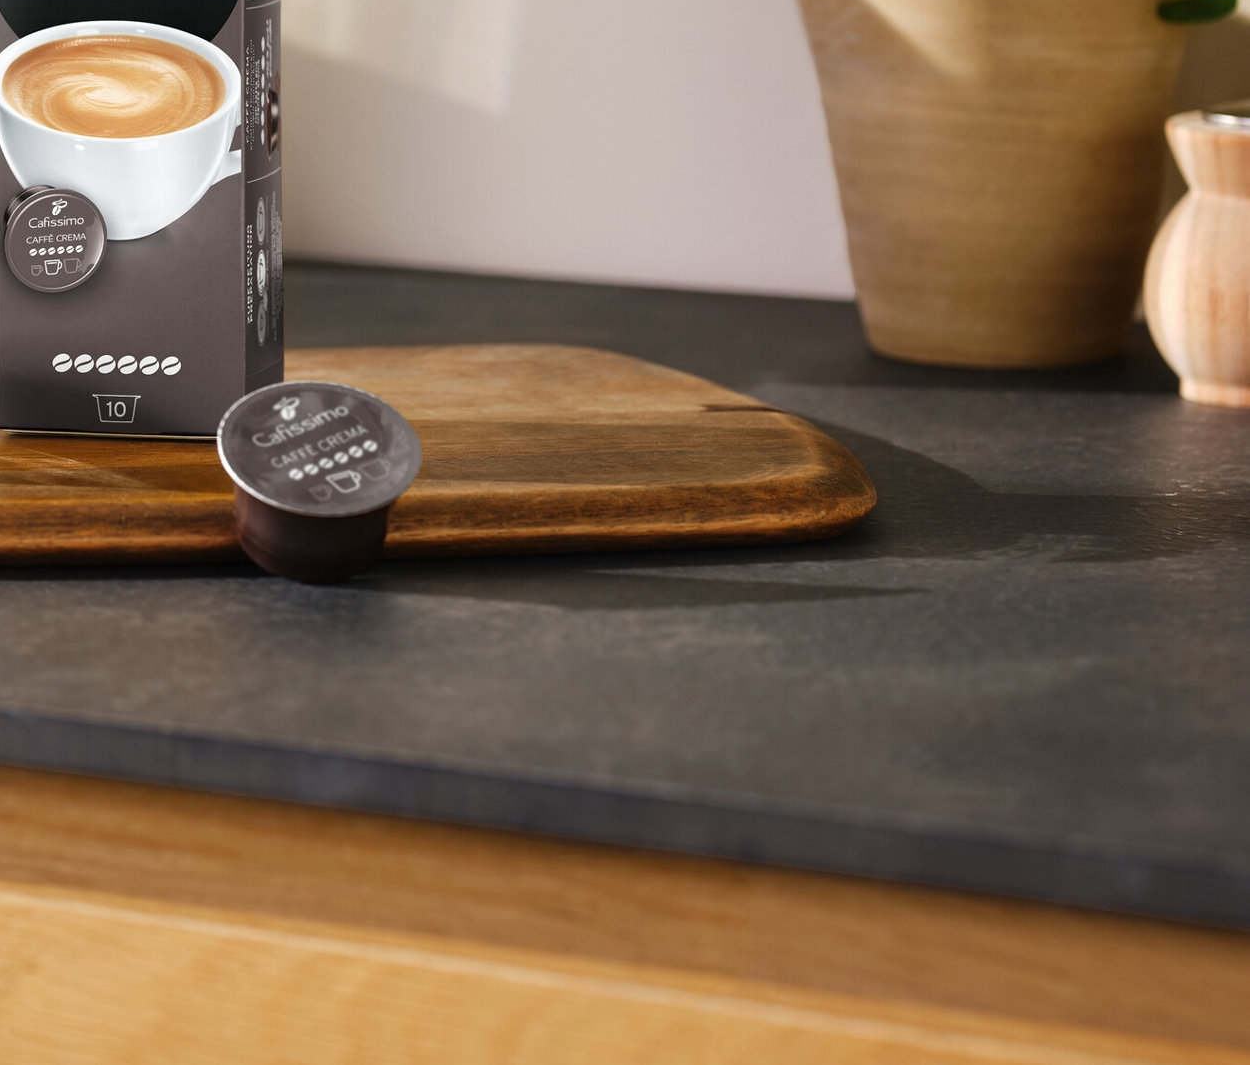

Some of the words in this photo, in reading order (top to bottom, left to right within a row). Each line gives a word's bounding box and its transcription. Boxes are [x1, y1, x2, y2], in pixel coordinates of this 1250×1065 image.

[28, 216, 85, 229] Cafissimo
[25, 234, 54, 245] CAFFÈ
[56, 233, 87, 243] CREMA
[105, 401, 127, 419] 10
[252, 405, 349, 447] Cafissimo
[270, 443, 318, 468] CAFFÈ
[317, 424, 369, 451] CREMA
